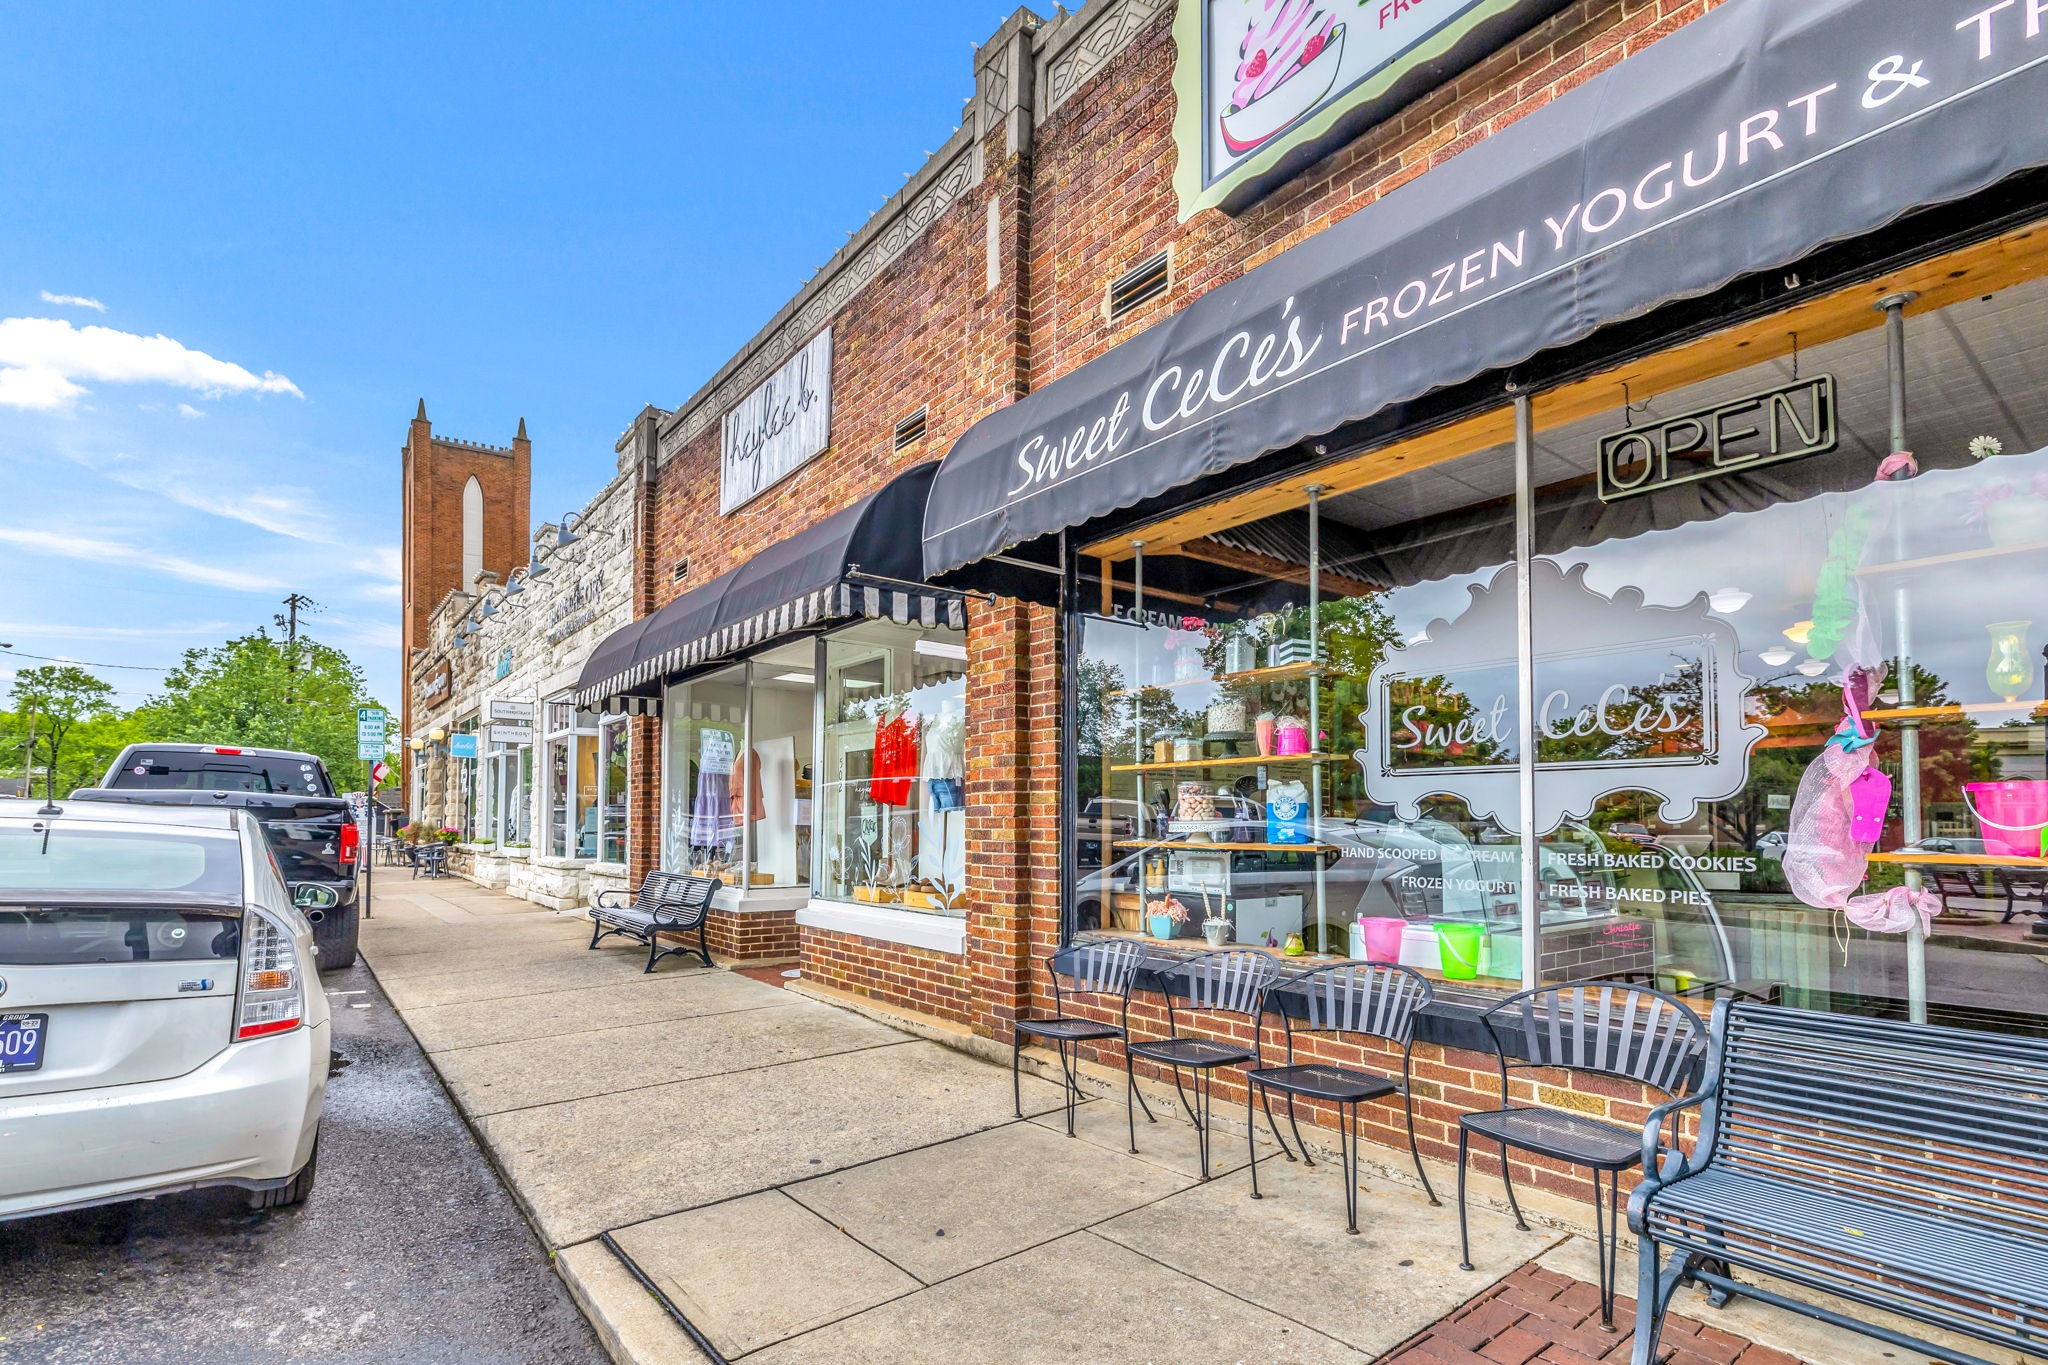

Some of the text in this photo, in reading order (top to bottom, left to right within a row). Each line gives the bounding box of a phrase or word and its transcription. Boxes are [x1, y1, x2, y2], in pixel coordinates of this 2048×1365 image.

[1379, 0, 1424, 30] FR
[1007, 391, 1130, 497] Sweet
[1142, 296, 1323, 431] CeCe's
[1340, 229, 1526, 345] FROZEN
[1544, 82, 1838, 251] YOGURT
[1860, 54, 1931, 110] &
[730, 382, 796, 493] haylee
[1607, 382, 1821, 489] OPEN
[360, 710, 367, 720] 4
[1397, 672, 1692, 749] Sweet CeCe's
[1340, 847, 1375, 859] HAND
[1377, 847, 1437, 861] SCOOPED
[1548, 852, 1757, 873] FRESH BAKED COOKIES
[1401, 876, 1516, 894] FROZEN YOGURT
[1549, 884, 1712, 906] FRESH BAKED PIES
[3, 1013, 30, 1021] GROUP
